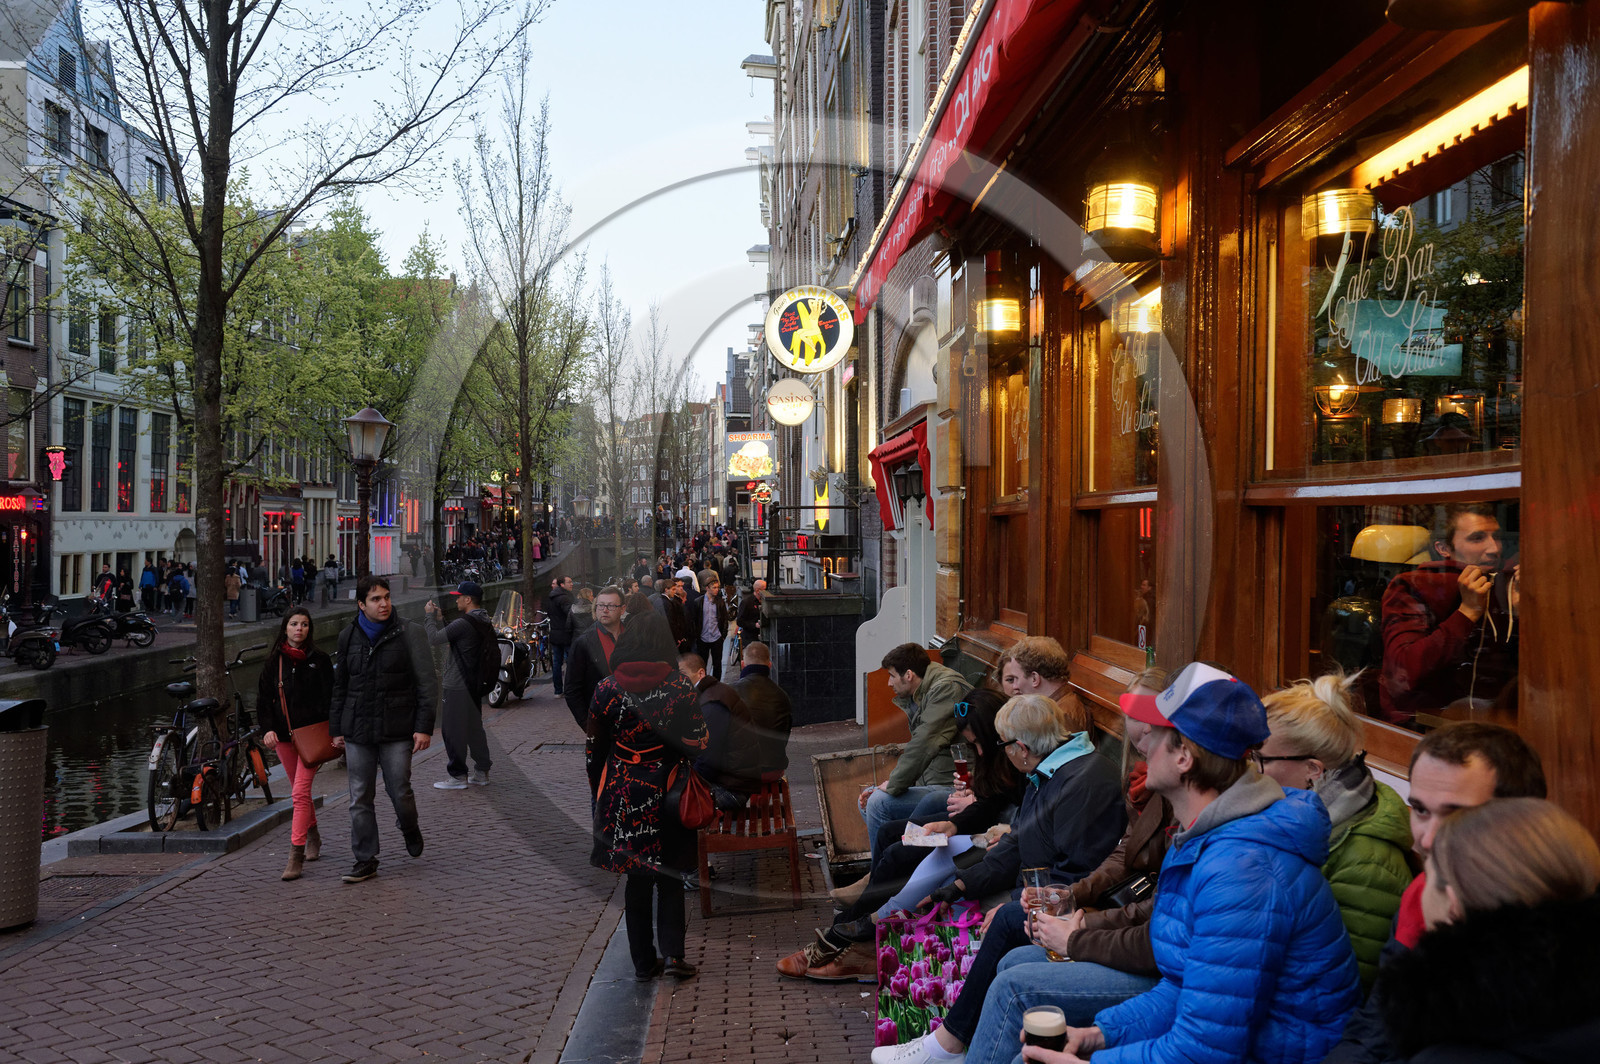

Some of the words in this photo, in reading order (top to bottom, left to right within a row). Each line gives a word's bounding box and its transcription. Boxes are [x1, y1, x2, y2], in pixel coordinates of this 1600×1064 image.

[786, 286, 849, 322] BANANAS
[1324, 225, 1373, 349] Café
[1379, 205, 1435, 317] Bar
[1355, 322, 1384, 386] Old
[1389, 288, 1446, 379] Sailor
[728, 432, 773, 442] SHOARMA
